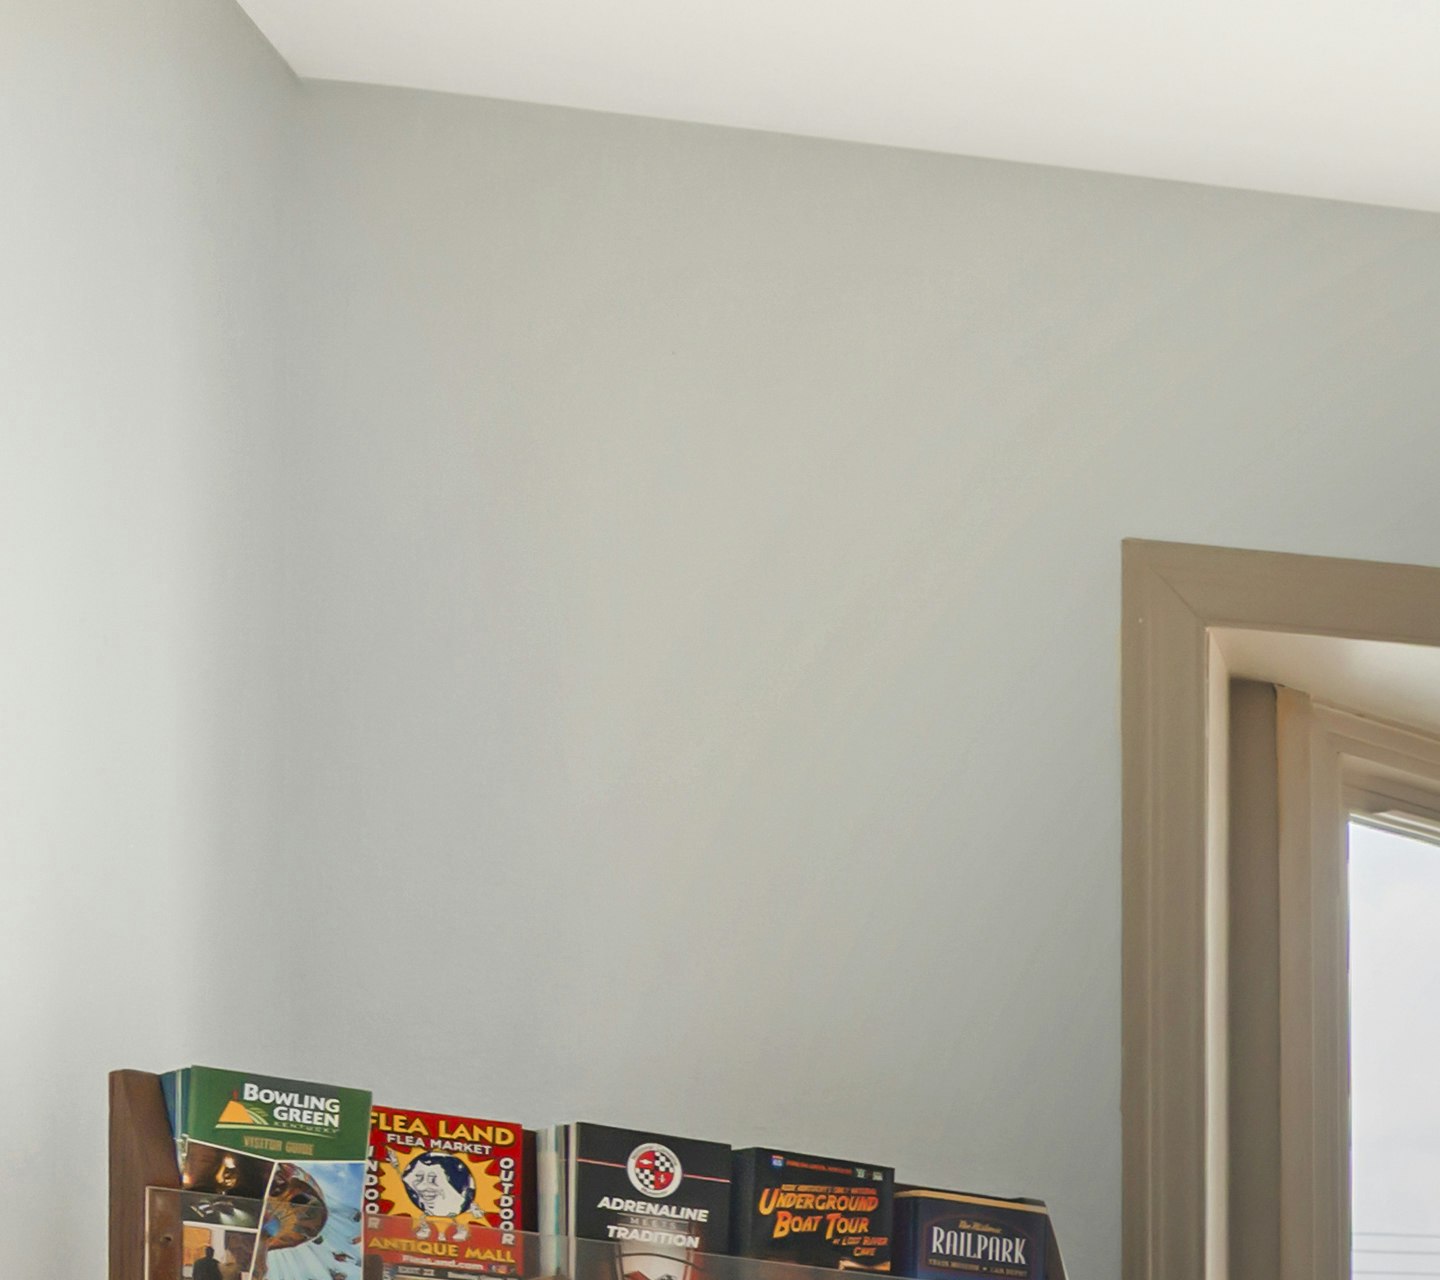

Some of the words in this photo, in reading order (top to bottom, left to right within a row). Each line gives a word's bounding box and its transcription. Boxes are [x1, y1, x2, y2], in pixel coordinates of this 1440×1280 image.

[243, 1083, 341, 1114] BOWLING
[273, 1104, 340, 1128] GREEN
[387, 1134, 425, 1147] FLEA
[430, 1139, 492, 1154] MARKET
[438, 1120, 515, 1145] LAND
[500, 1158, 515, 1245] OUTDOOR
[597, 1196, 709, 1223] ADRENALINE
[607, 1224, 700, 1249] TRADITION
[931, 1225, 1028, 1266] RAILPARK
[368, 1237, 459, 1257] ANTIQUE
[465, 1248, 515, 1263] MALL
